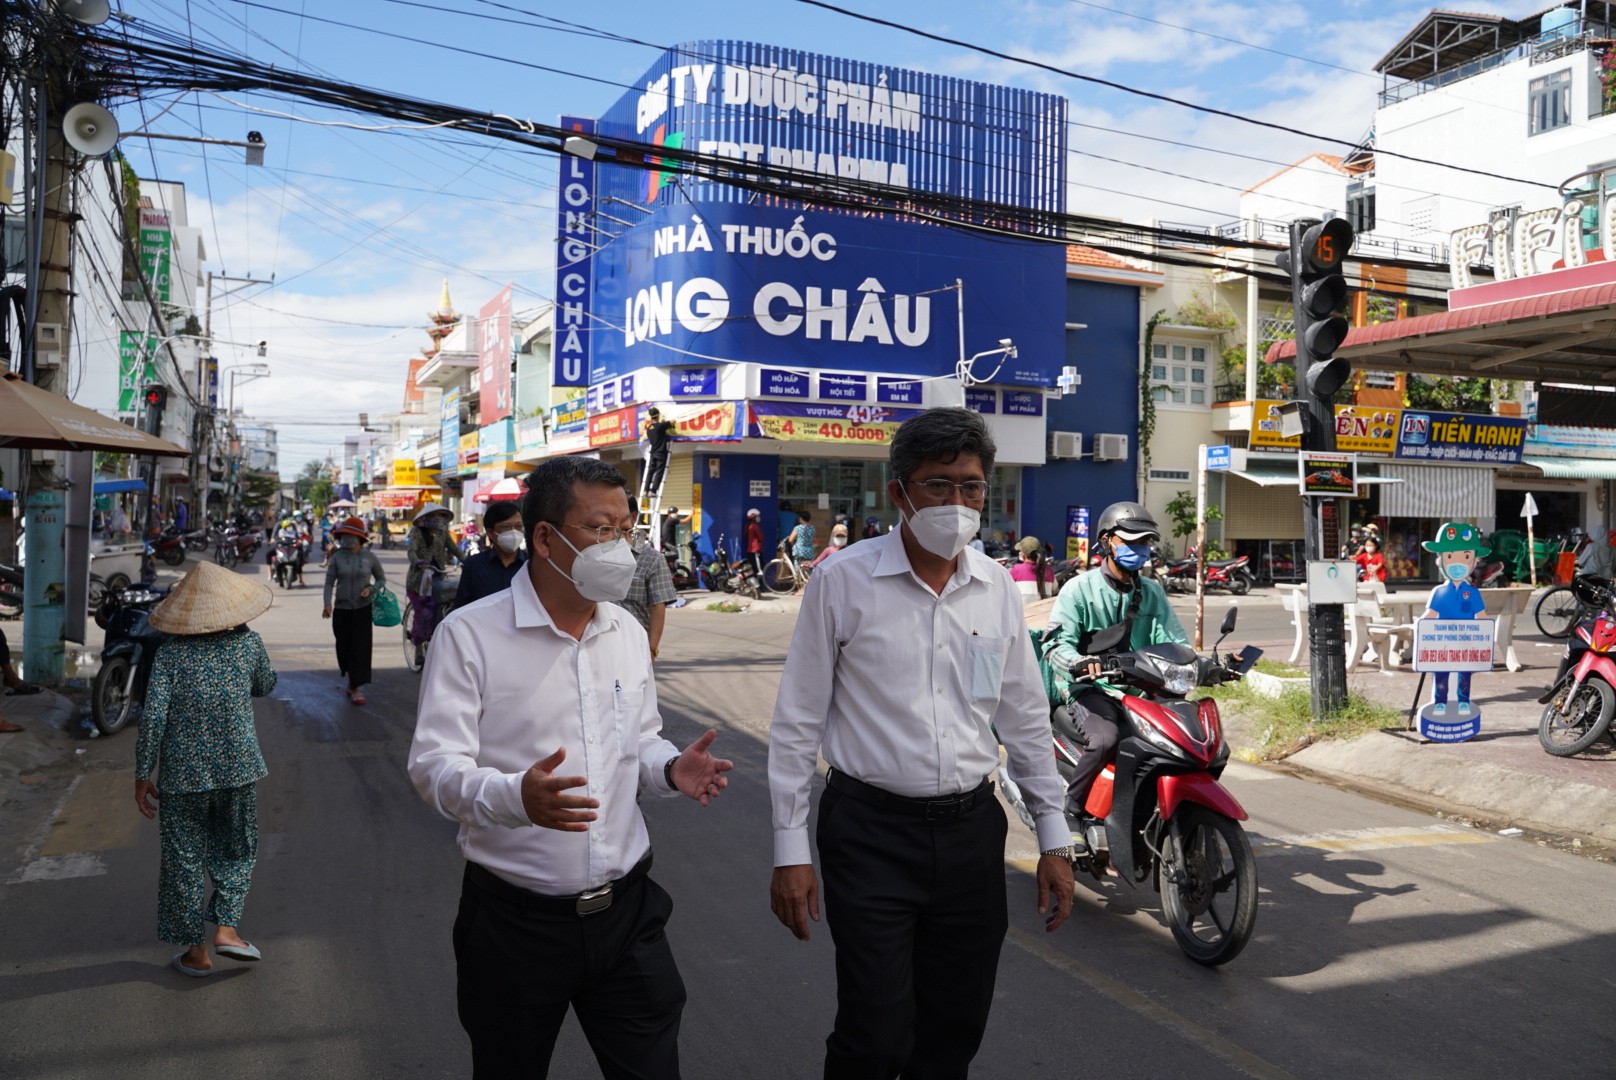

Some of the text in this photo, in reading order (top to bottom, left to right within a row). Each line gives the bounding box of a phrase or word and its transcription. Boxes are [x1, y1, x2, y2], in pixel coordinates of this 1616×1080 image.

[671, 64, 716, 107] TY
[724, 63, 819, 118] DƯỢC
[826, 73, 921, 132] PHẨM
[654, 214, 837, 261] NHÀ THUỐC
[1316, 236, 1335, 262] 15
[625, 277, 931, 347] LONG CHÂU
[561, 272, 586, 383] CHÂU
[683, 385, 703, 393] GOUT
[769, 385, 783, 394] TIÊU
[782, 419, 795, 435] 4
[1406, 417, 1426, 432] IN
[1474, 425, 1522, 449] HẠNH
[1120, 750, 1136, 758] HONDA
